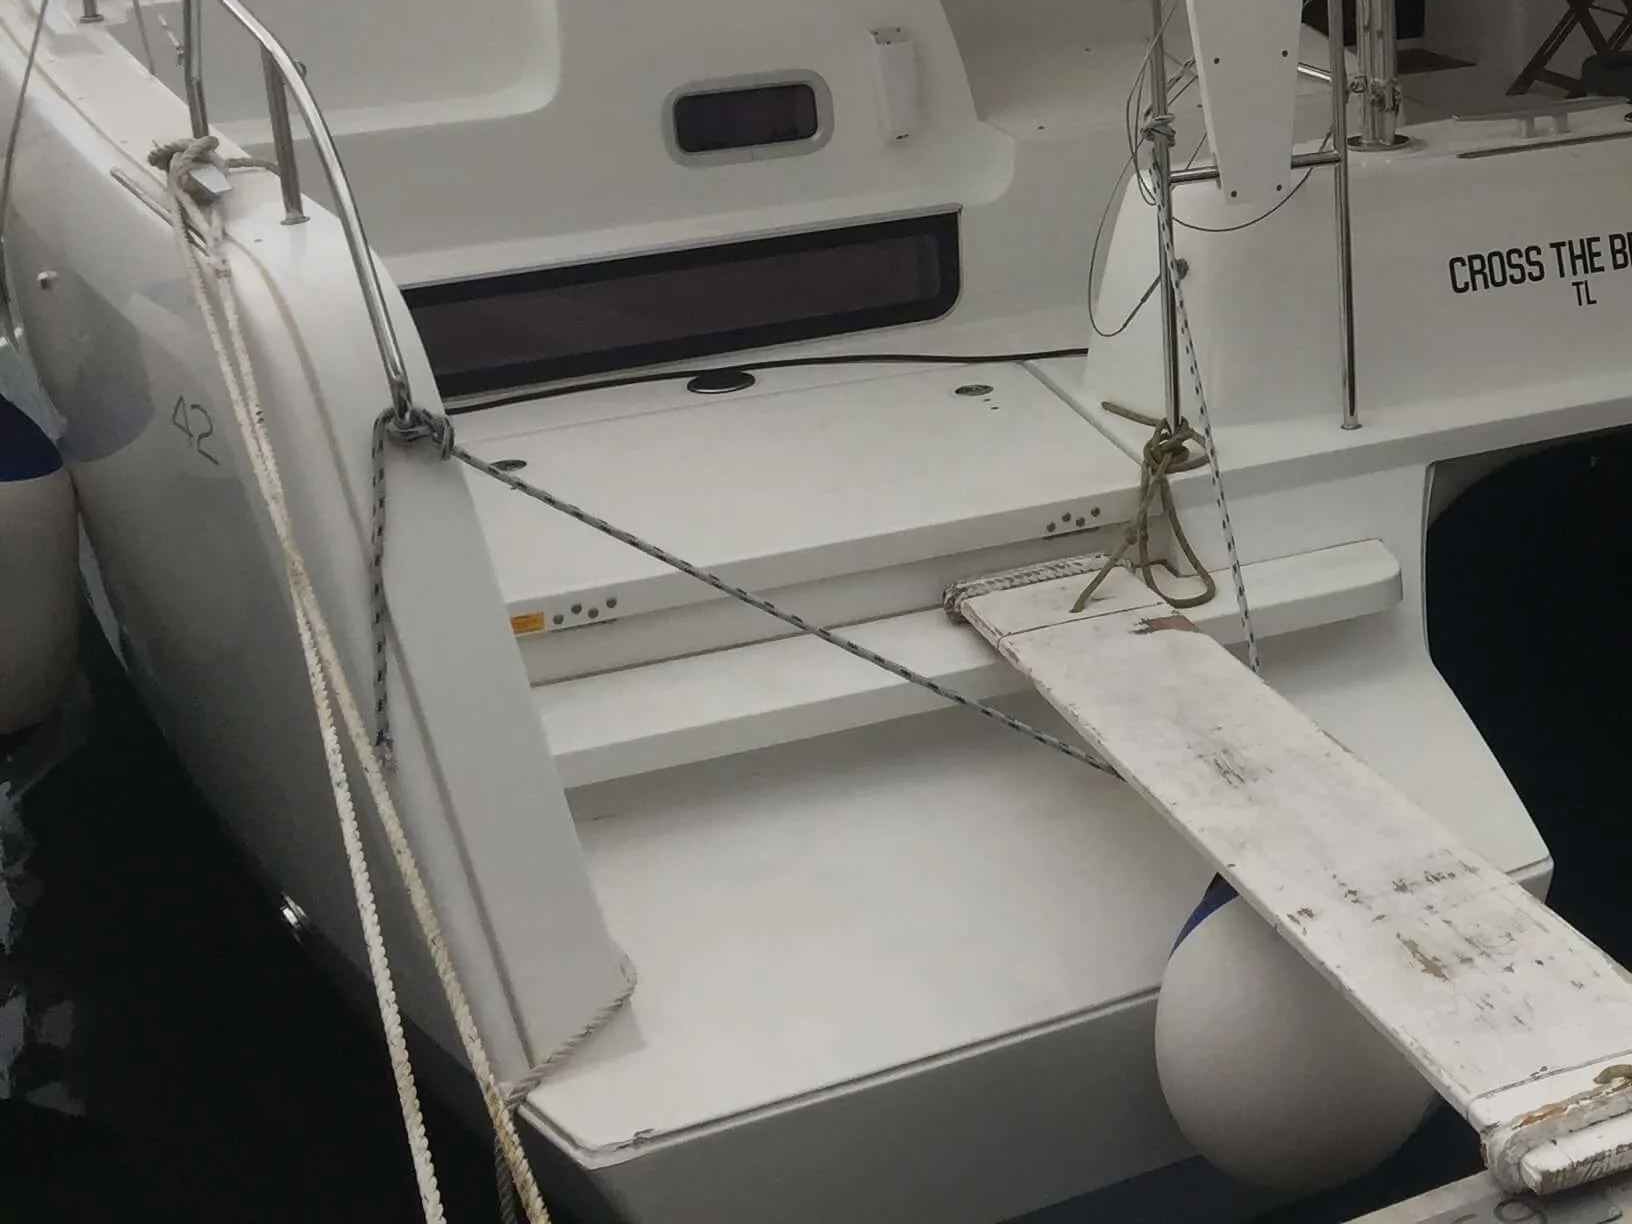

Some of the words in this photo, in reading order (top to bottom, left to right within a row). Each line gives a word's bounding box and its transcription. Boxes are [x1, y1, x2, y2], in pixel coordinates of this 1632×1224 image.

[1448, 245, 1546, 294] CROSS
[1549, 236, 1606, 278] THE
[1571, 280, 1598, 307] TL
